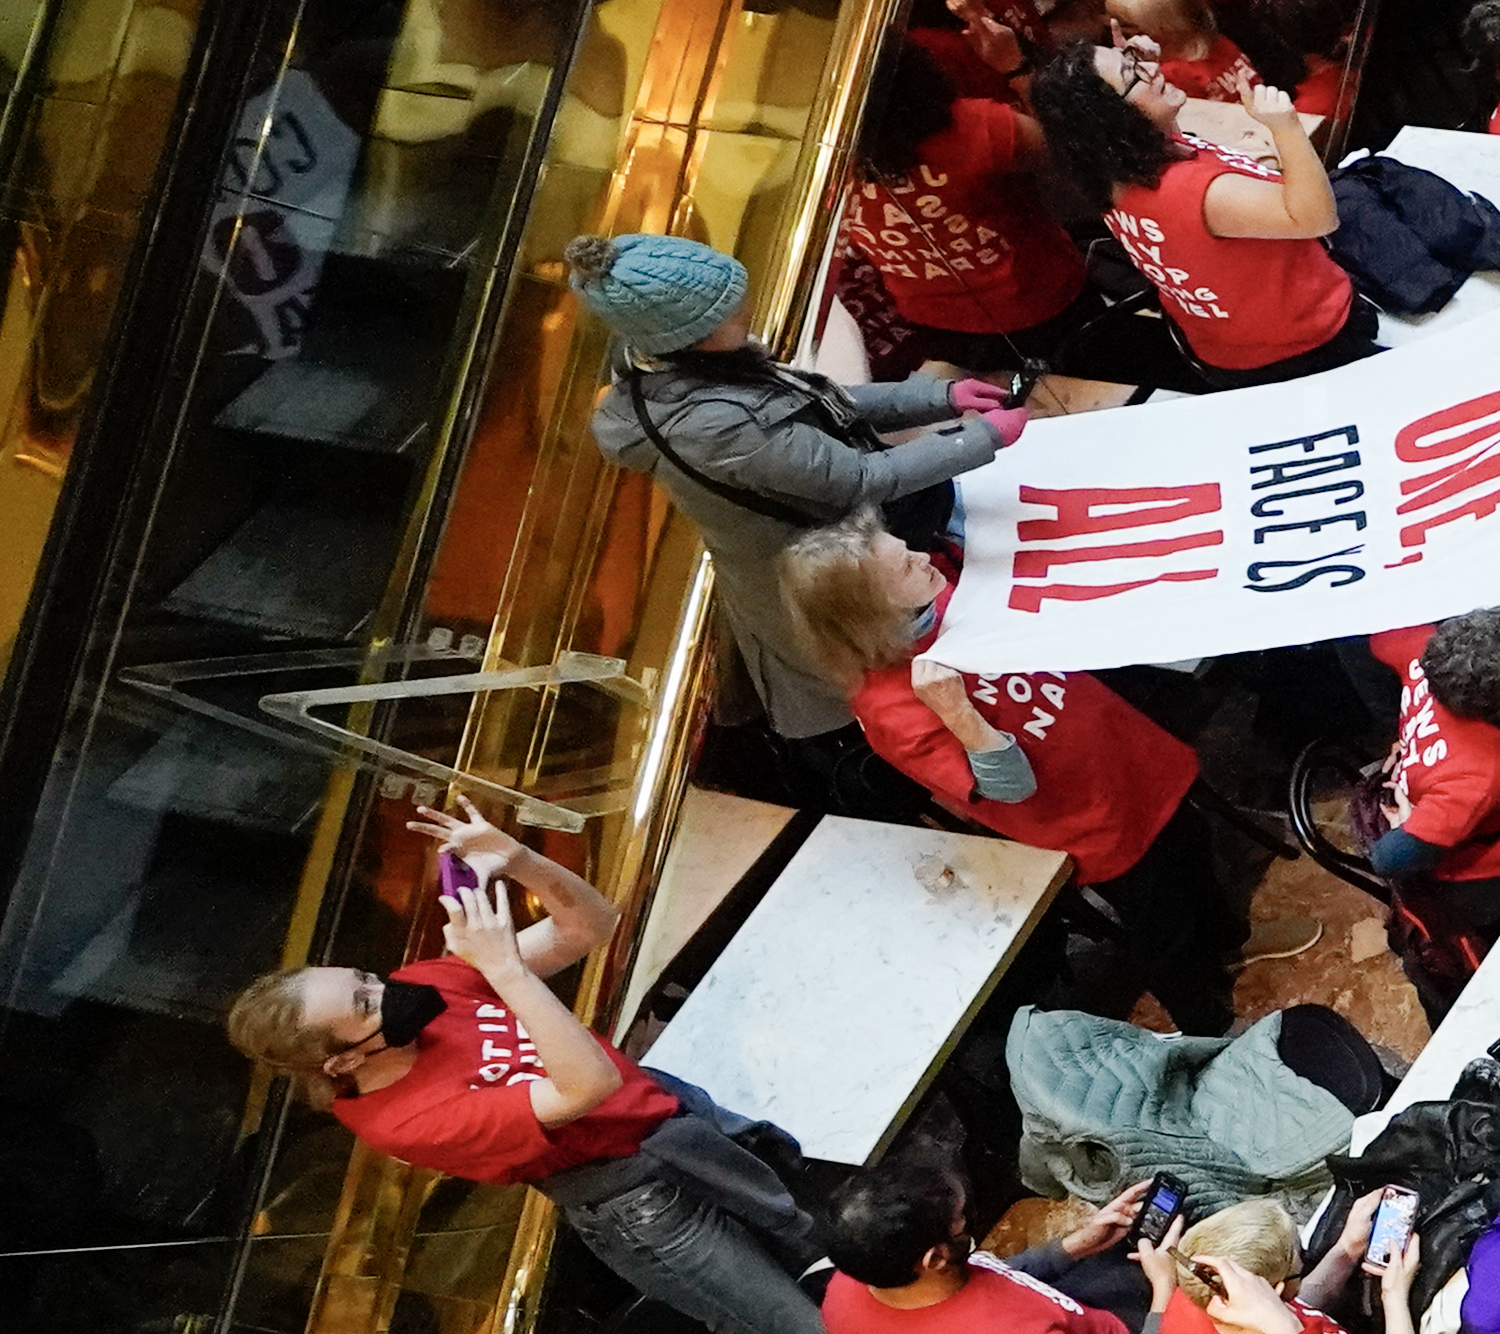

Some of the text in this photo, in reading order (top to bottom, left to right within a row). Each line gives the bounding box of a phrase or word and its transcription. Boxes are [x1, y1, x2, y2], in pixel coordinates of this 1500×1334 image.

[1248, 424, 1367, 545] FACE
[1007, 482, 1224, 614] ALL
[475, 1003, 509, 1034] IN
